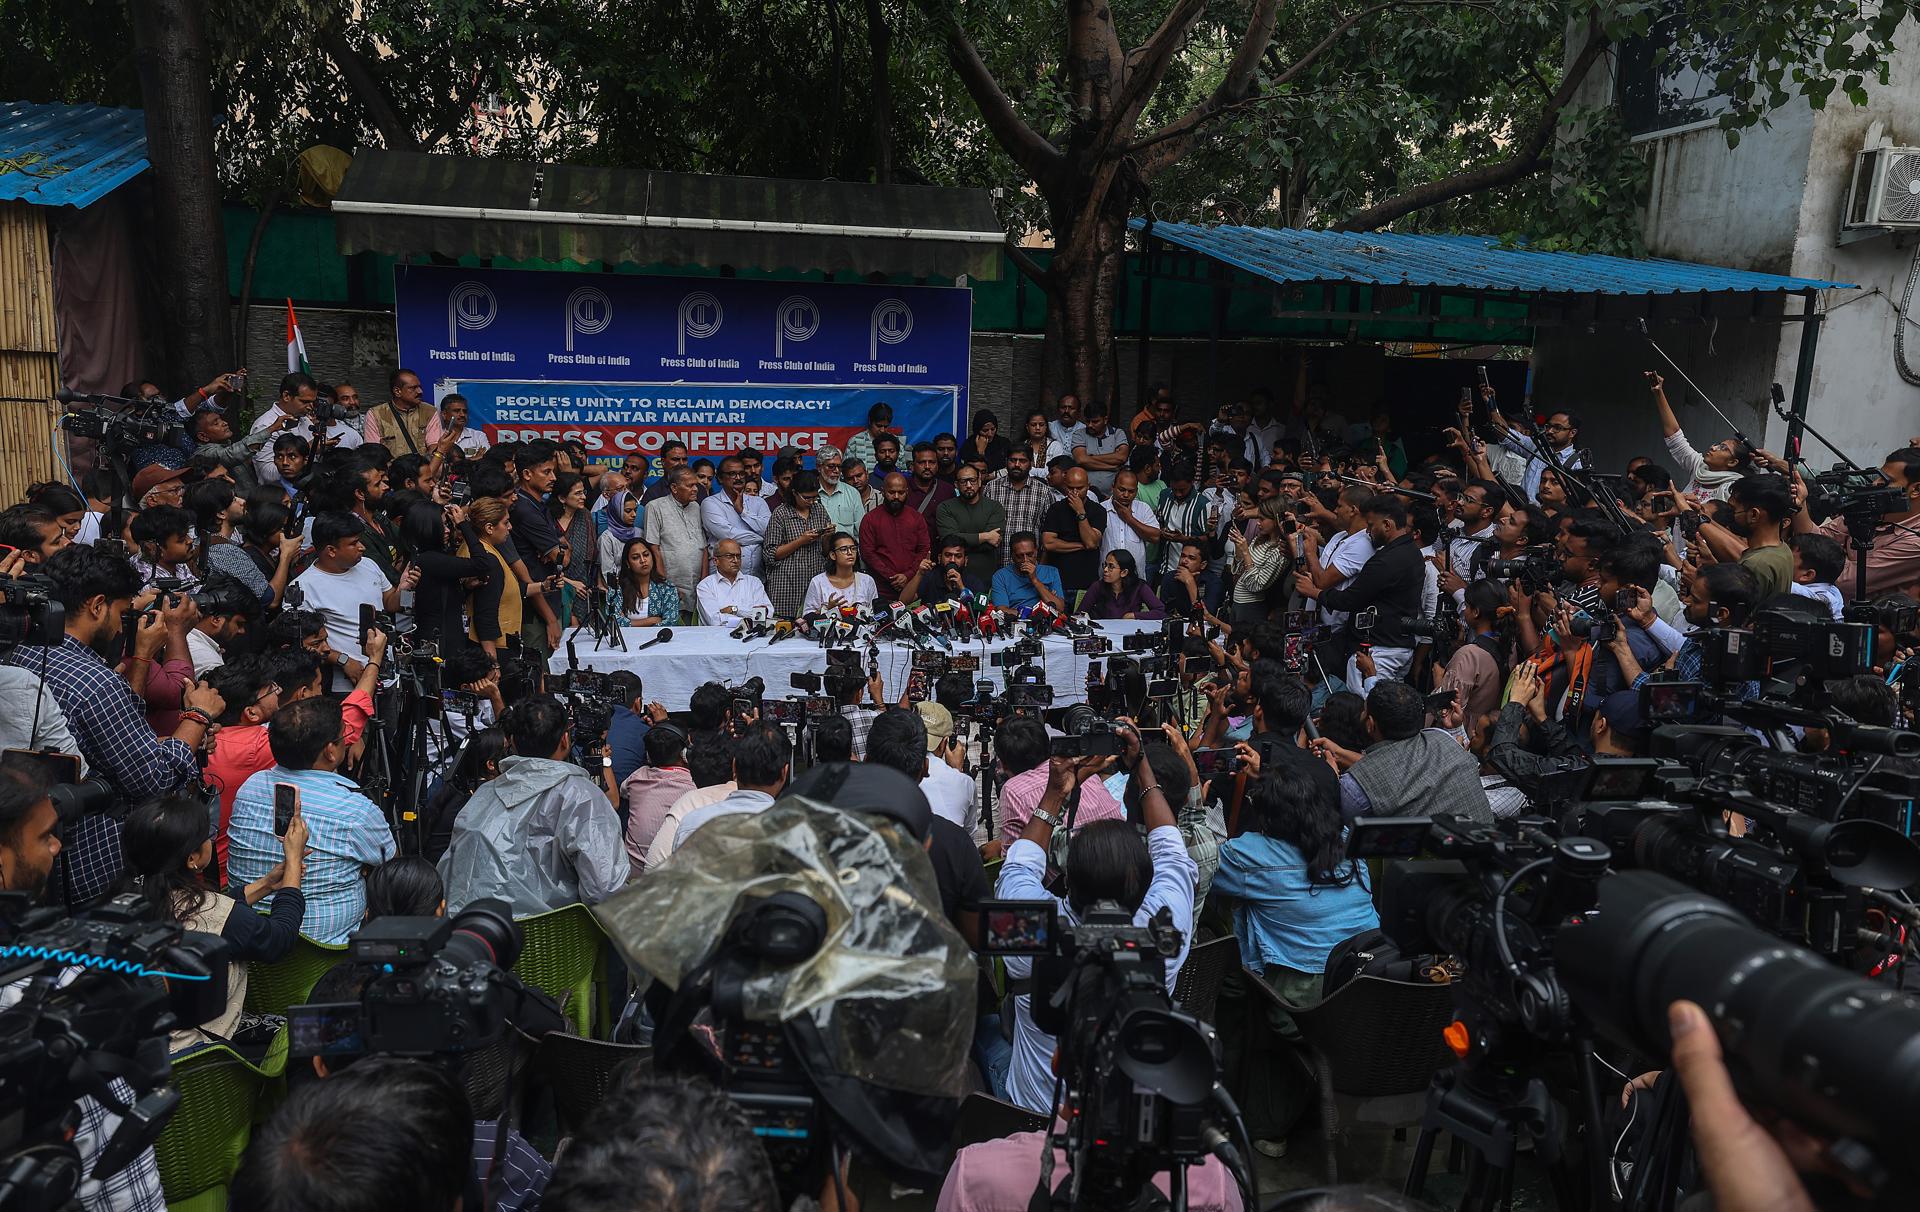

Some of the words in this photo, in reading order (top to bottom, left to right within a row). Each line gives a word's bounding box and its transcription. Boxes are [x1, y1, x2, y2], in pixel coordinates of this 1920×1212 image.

[429, 349, 456, 359] Press
[458, 350, 479, 361] Club
[481, 352, 490, 361] of
[491, 352, 516, 361] India
[548, 353, 573, 363] Press
[575, 355, 595, 364] Club
[597, 356, 606, 364] of
[607, 356, 631, 365] India
[661, 357, 685, 367] Press
[686, 358, 706, 367] Club
[707, 358, 716, 368] of
[717, 359, 739, 369] India
[758, 360, 782, 369] Press
[784, 361, 802, 370] Club
[804, 362, 812, 370] of
[813, 362, 835, 371] India
[853, 363, 876, 372] Press
[877, 363, 896, 372] Club
[897, 363, 906, 373] of
[907, 364, 928, 373] India
[496, 396, 571, 407] PEOPLE'S
[576, 397, 625, 408] UNITY
[629, 398, 652, 408] TO
[657, 399, 725, 409] RECLAIM
[729, 400, 831, 410] DEMOCRACY!
[496, 409, 580, 422] RECLAIM
[585, 411, 657, 423] JANTAR
[663, 412, 746, 423] MANTAR!
[614, 431, 829, 451] CONFERENCE
